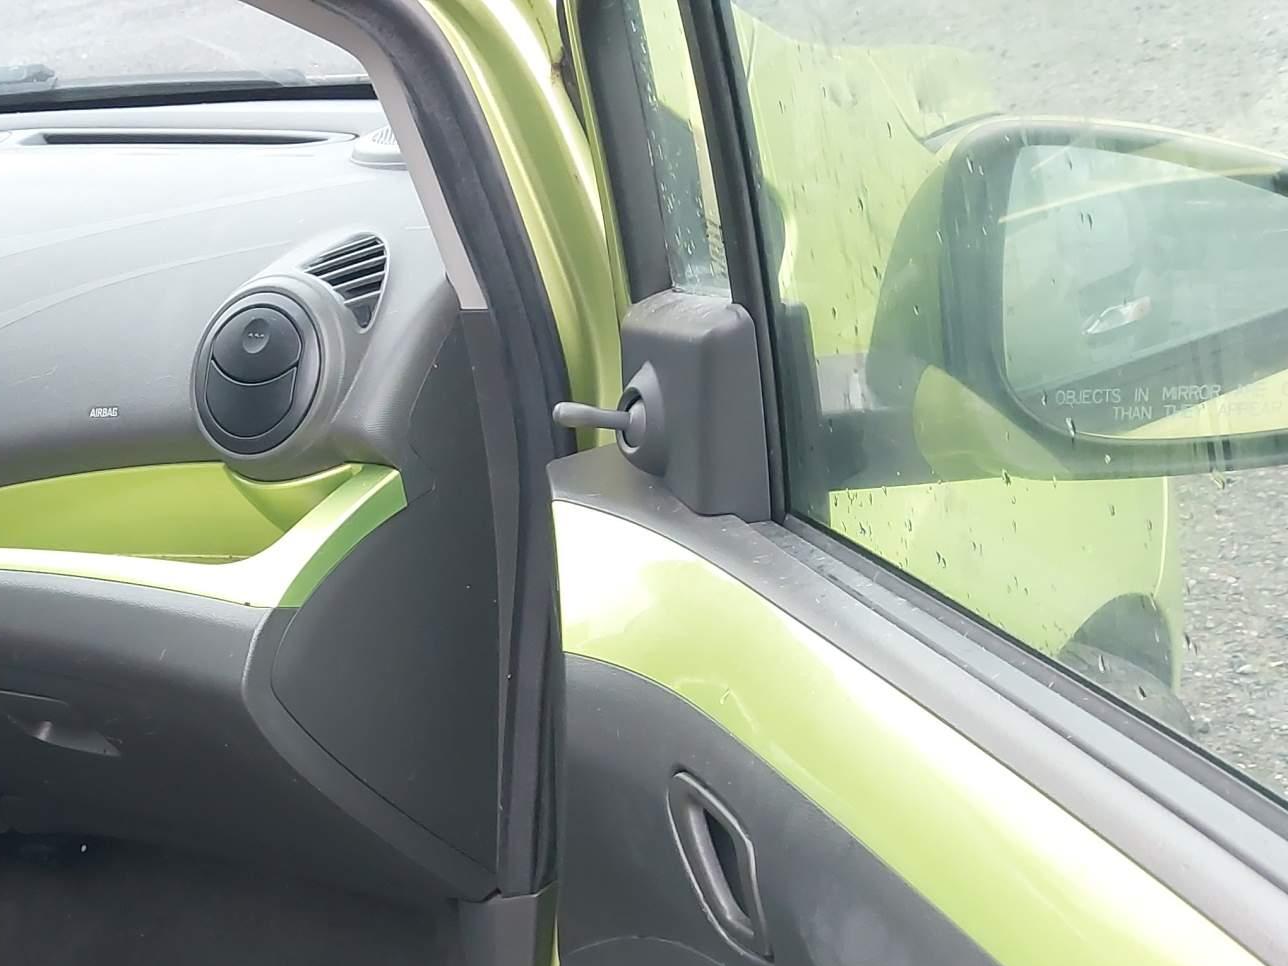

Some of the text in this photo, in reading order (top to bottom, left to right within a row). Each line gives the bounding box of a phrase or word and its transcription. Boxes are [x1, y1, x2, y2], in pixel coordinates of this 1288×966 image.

[1055, 387, 1121, 405] OBJECTS
[1134, 387, 1150, 402] IN
[1162, 384, 1222, 401] MIRROR
[89, 407, 119, 418] AIRBAG
[1113, 404, 1153, 420] THAN
